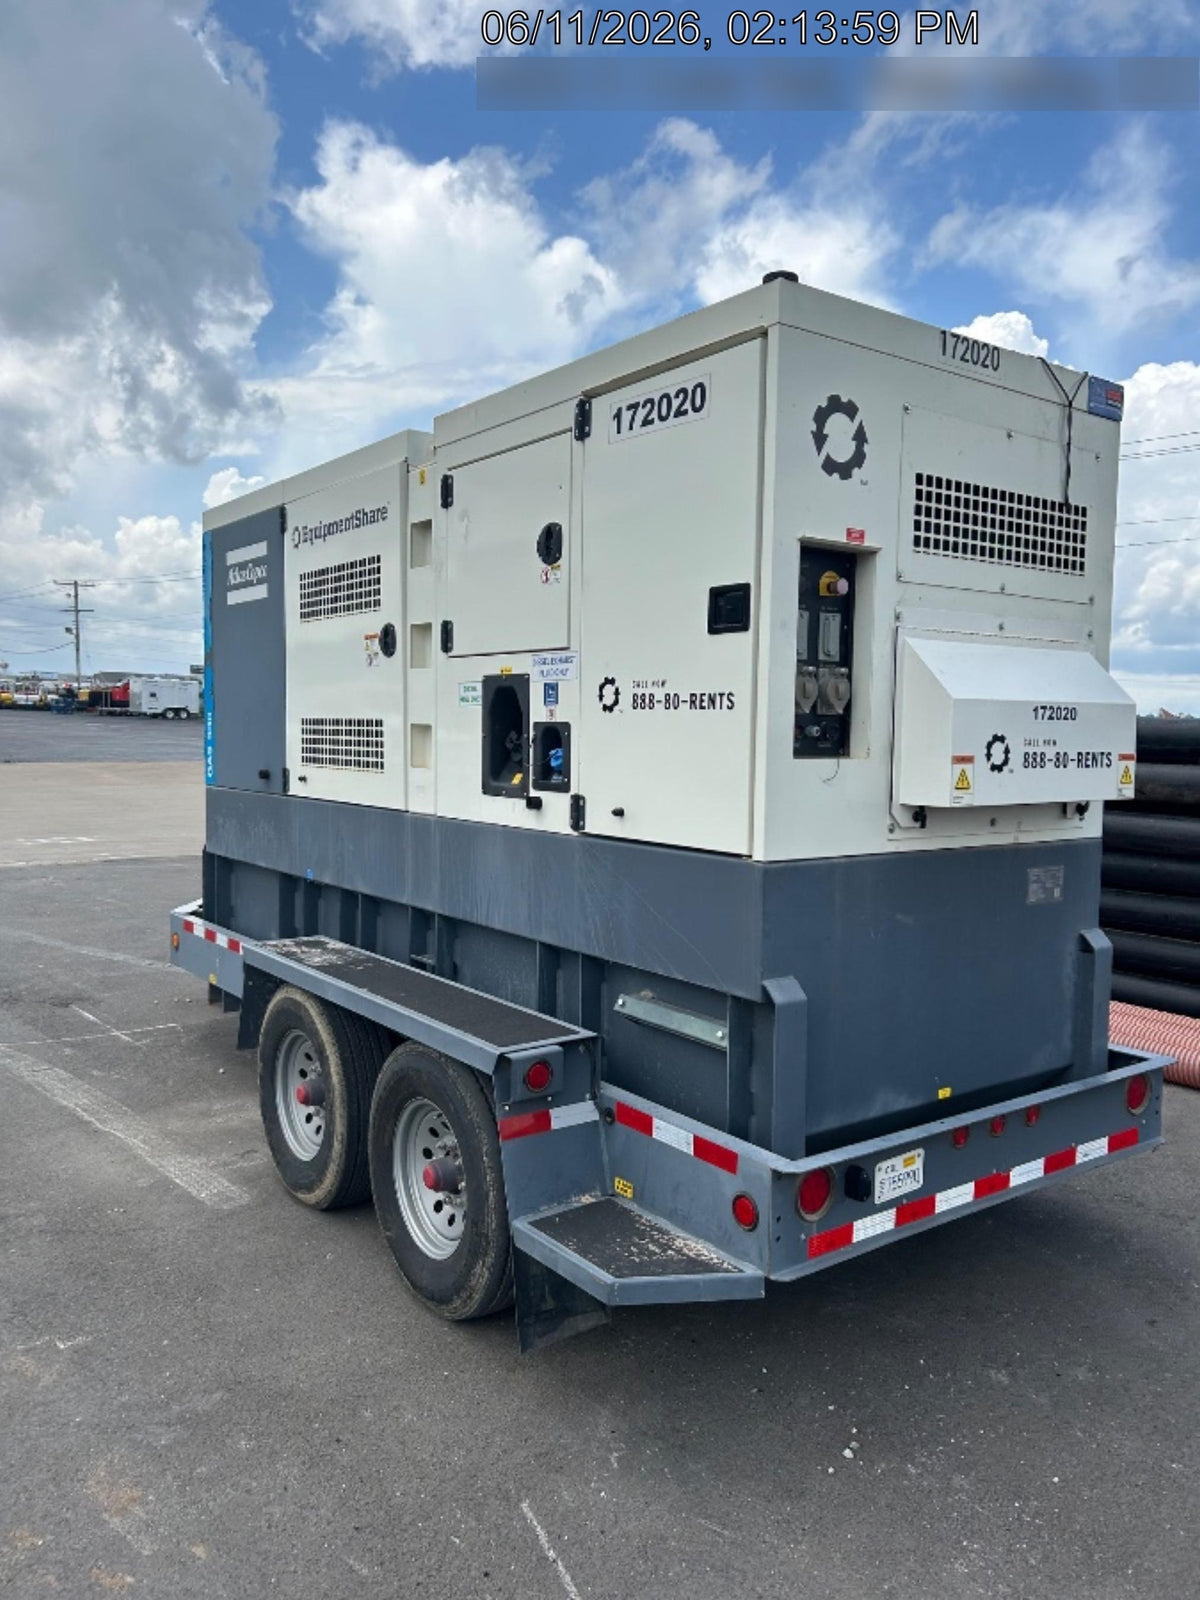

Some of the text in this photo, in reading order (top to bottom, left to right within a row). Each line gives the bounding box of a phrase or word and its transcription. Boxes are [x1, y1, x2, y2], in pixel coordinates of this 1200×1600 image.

[940, 330, 1000, 371] 172020
[612, 381, 707, 434] 172020
[302, 504, 389, 546] EquipmentShare
[632, 691, 735, 710] 888-80-RENTS
[1033, 705, 1078, 721] 172020
[1023, 751, 1112, 769] 888-80-RENTS
